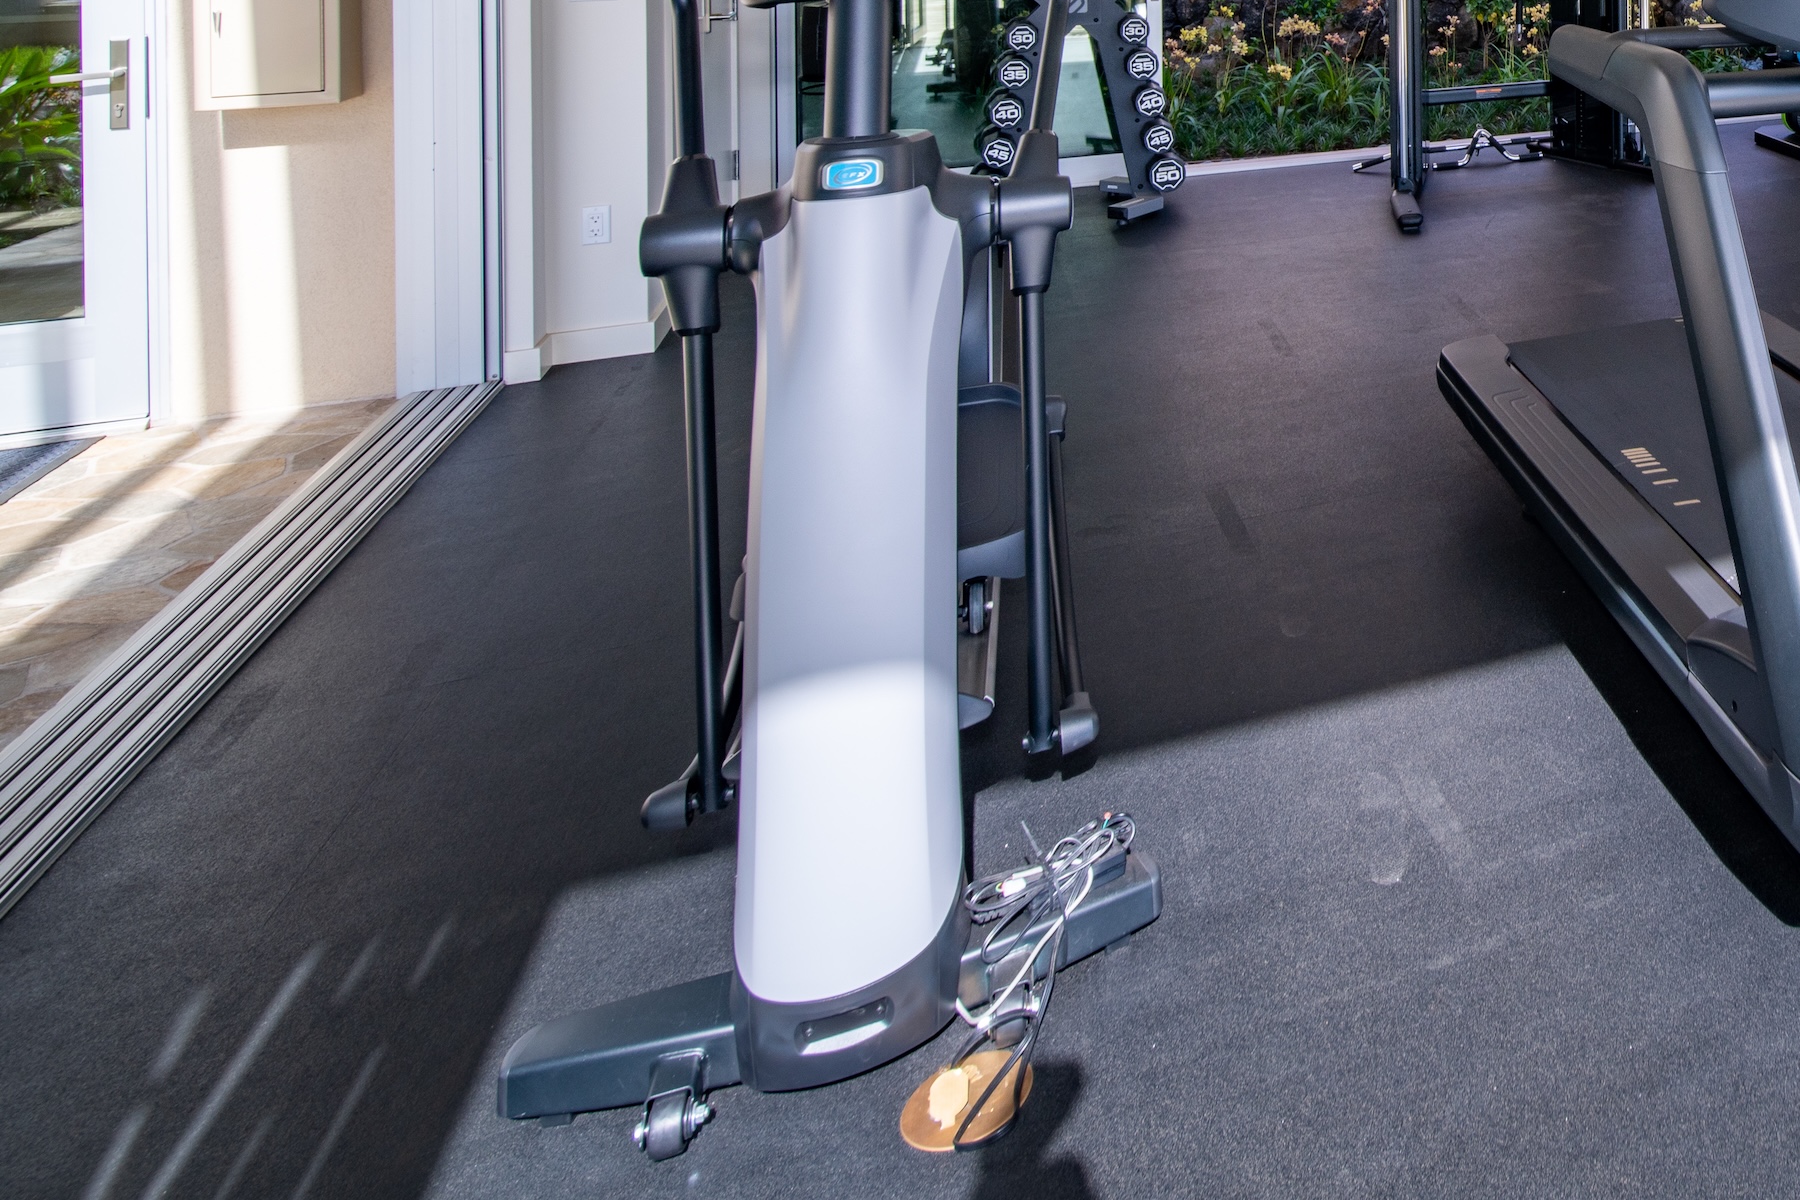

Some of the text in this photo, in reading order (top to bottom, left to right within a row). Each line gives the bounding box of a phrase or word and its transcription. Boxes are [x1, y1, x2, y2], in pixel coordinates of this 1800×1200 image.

[1125, 27, 1145, 36] 30
[1011, 34, 1033, 44] 30
[1132, 61, 1154, 72] 35
[1003, 70, 1027, 81] 35
[1141, 98, 1163, 110] 40
[995, 108, 1019, 120] 40
[1150, 134, 1169, 146] 45
[988, 149, 1010, 161] 45
[1155, 170, 1180, 182] 50
